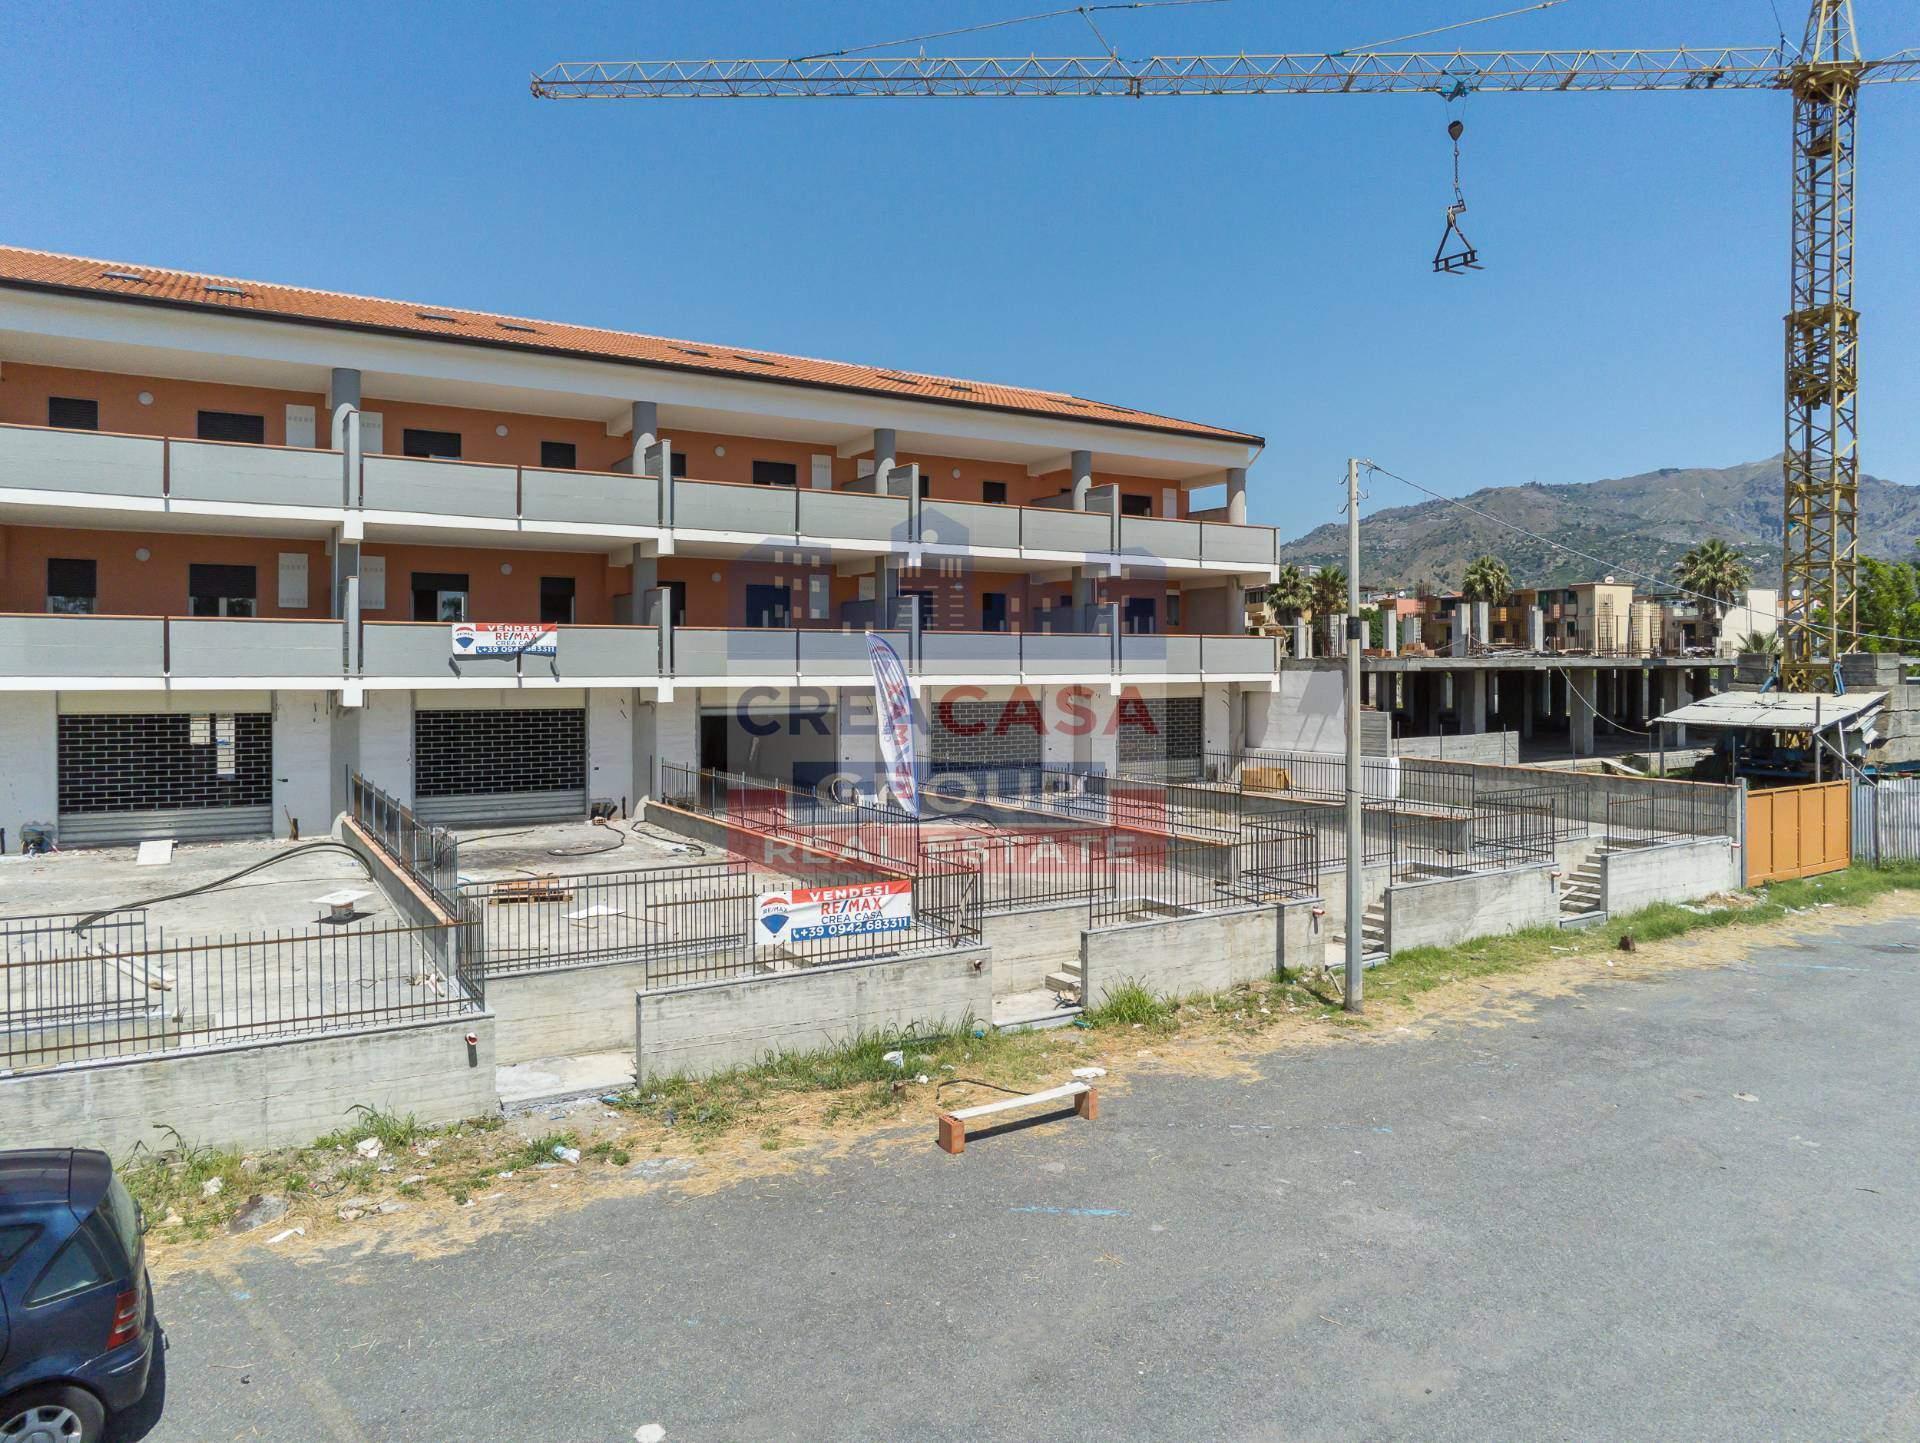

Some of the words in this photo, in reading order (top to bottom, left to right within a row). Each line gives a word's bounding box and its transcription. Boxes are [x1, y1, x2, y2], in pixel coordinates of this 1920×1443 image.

[809, 885, 889, 901] VENDESI
[821, 897, 882, 915] RE/MAX
[821, 915, 851, 925] CREA
[854, 911, 883, 920] CASA
[801, 929, 824, 938] +39
[828, 917, 908, 934] 0942.683311
